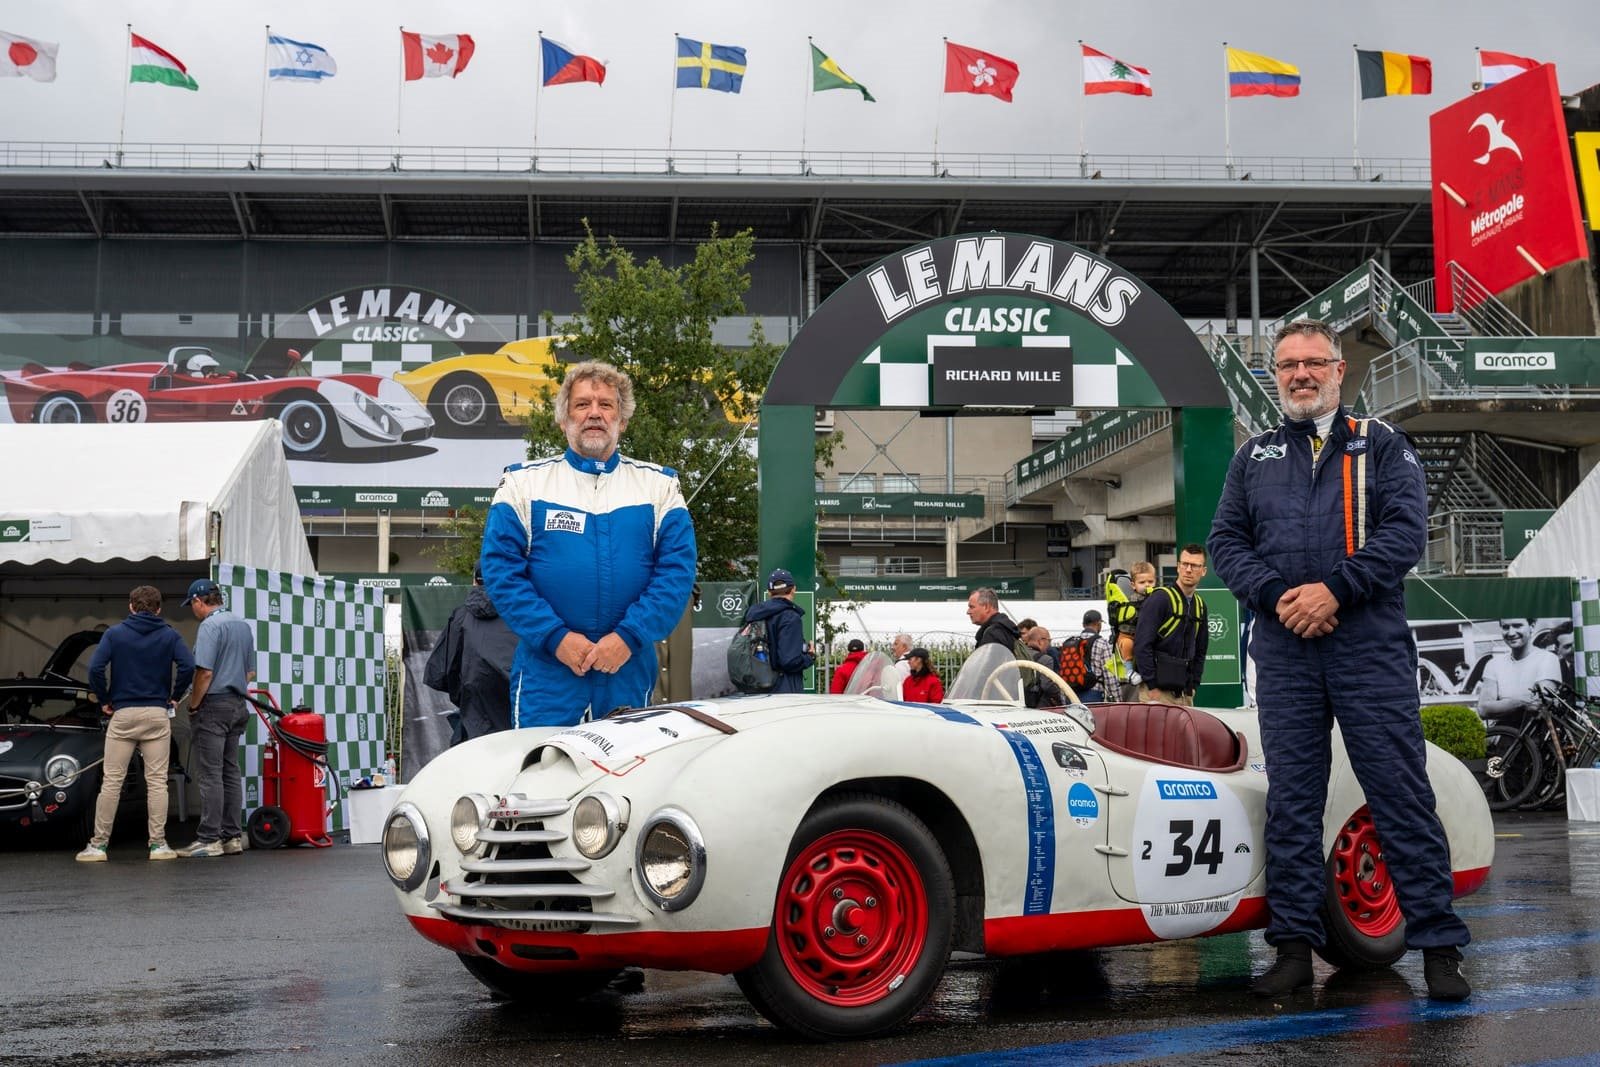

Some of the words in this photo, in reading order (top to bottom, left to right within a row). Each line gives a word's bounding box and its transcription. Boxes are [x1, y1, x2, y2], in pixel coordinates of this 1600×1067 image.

[1471, 193, 1524, 237] Métropole
[867, 246, 943, 324] LE
[947, 236, 1142, 327] MANS
[307, 295, 350, 336] LE
[357, 289, 474, 339] MANS
[945, 307, 1051, 333] CLASSIC
[352, 326, 419, 342] CLASSIC
[1483, 356, 1548, 367] aramco
[945, 370, 1011, 381] RICHARD
[1016, 371, 1061, 381] MILLE
[111, 399, 142, 423] 36
[582, 732, 614, 756] JOURNAL
[1163, 784, 1211, 796] aramco
[1070, 800, 1096, 808] aramco
[1141, 840, 1152, 860] 2
[1165, 819, 1224, 877] 34
[1150, 905, 1164, 917] THE
[1164, 904, 1180, 916] WALL
[1180, 902, 1204, 914] STREET
[1202, 900, 1230, 914] JOURNAL
